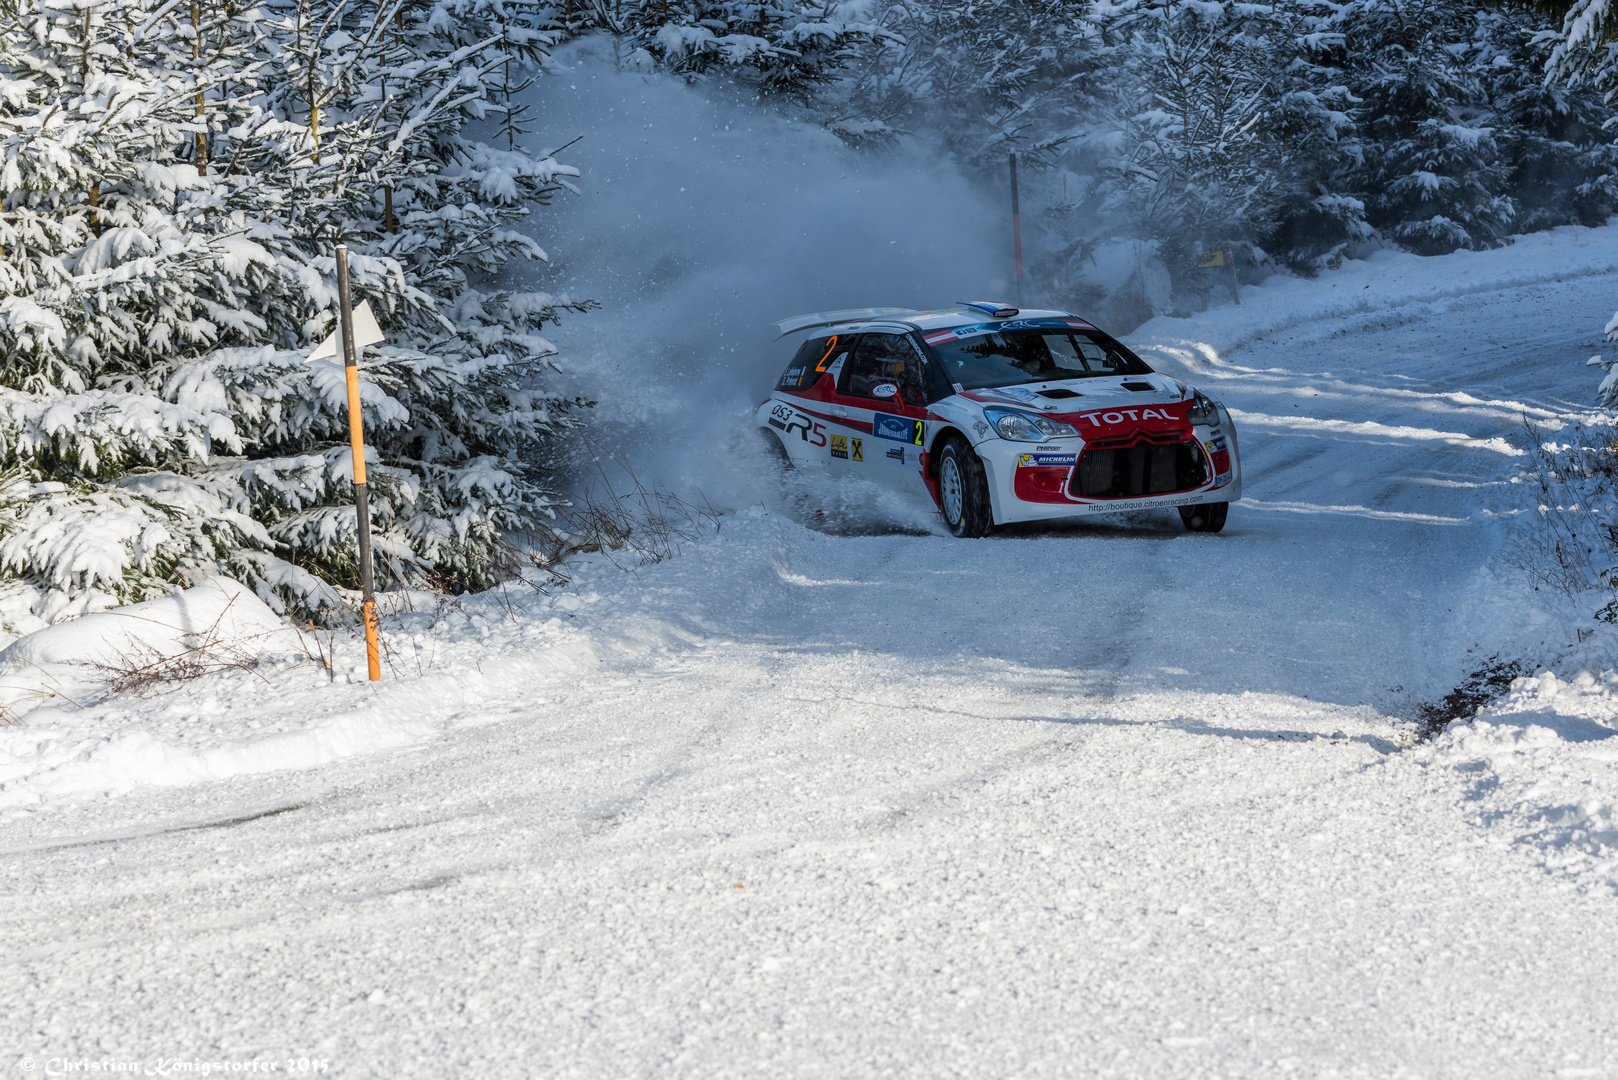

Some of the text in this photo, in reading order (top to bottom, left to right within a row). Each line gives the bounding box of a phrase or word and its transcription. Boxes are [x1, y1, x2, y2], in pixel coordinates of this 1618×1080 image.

[815, 335, 838, 372] 2
[875, 385, 896, 394] ERC
[1080, 408, 1180, 427] TOTAL
[914, 421, 923, 446] 2
[1088, 495, 1204, 513] http://boutique.citroenracing.com
